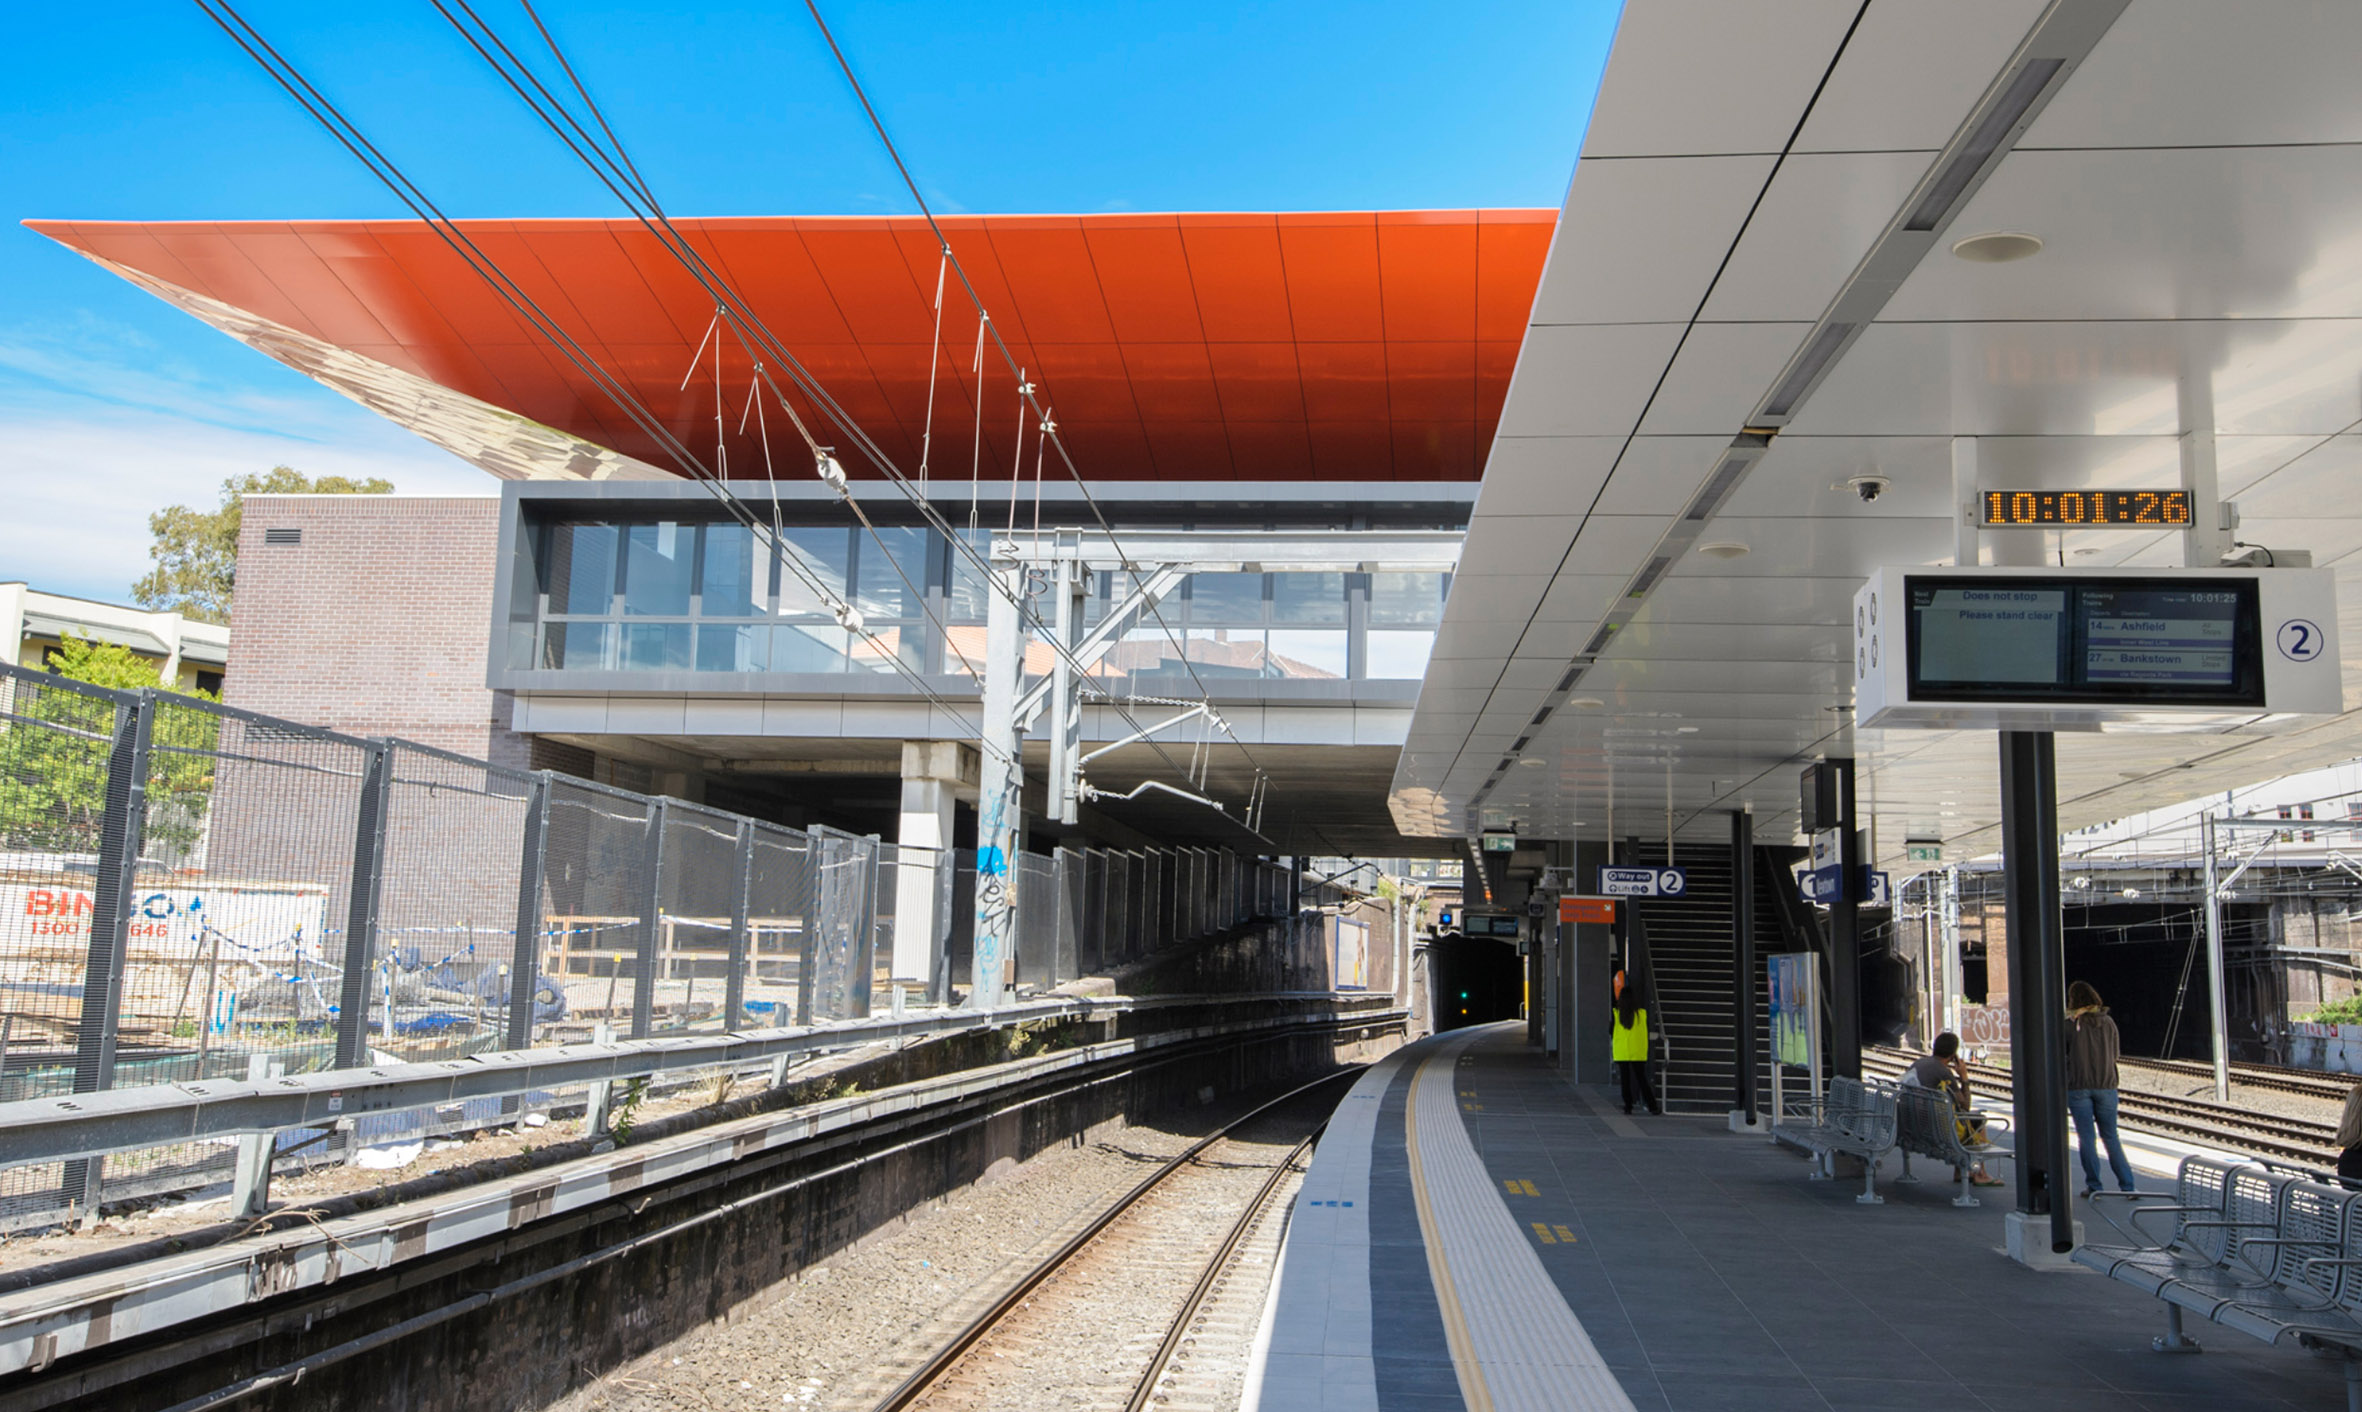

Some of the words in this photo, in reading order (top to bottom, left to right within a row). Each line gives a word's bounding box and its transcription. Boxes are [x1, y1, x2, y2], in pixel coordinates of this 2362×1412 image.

[1987, 492, 2188, 524] 10:01:26
[1962, 591, 1990, 600] Does
[1993, 591, 2011, 600] not
[2014, 592, 2038, 602] stop
[2190, 592, 2238, 604] 10:01:25
[1959, 610, 1994, 620] Please
[1996, 610, 2025, 620] stand
[2027, 611, 2054, 620] clear
[2090, 622, 2102, 630] 14
[2120, 621, 2167, 632] Ashfield
[2291, 625, 2310, 655] 2
[2089, 653, 2102, 662] 27
[2120, 653, 2182, 664] Bankstown
[1617, 871, 1635, 881] Way
[1636, 872, 1650, 880] out
[1666, 873, 1678, 891] 2
[1618, 884, 1630, 892] Lift
[26, 890, 174, 919] BINO
[32, 921, 79, 935] 1300
[130, 923, 168, 937] 646
